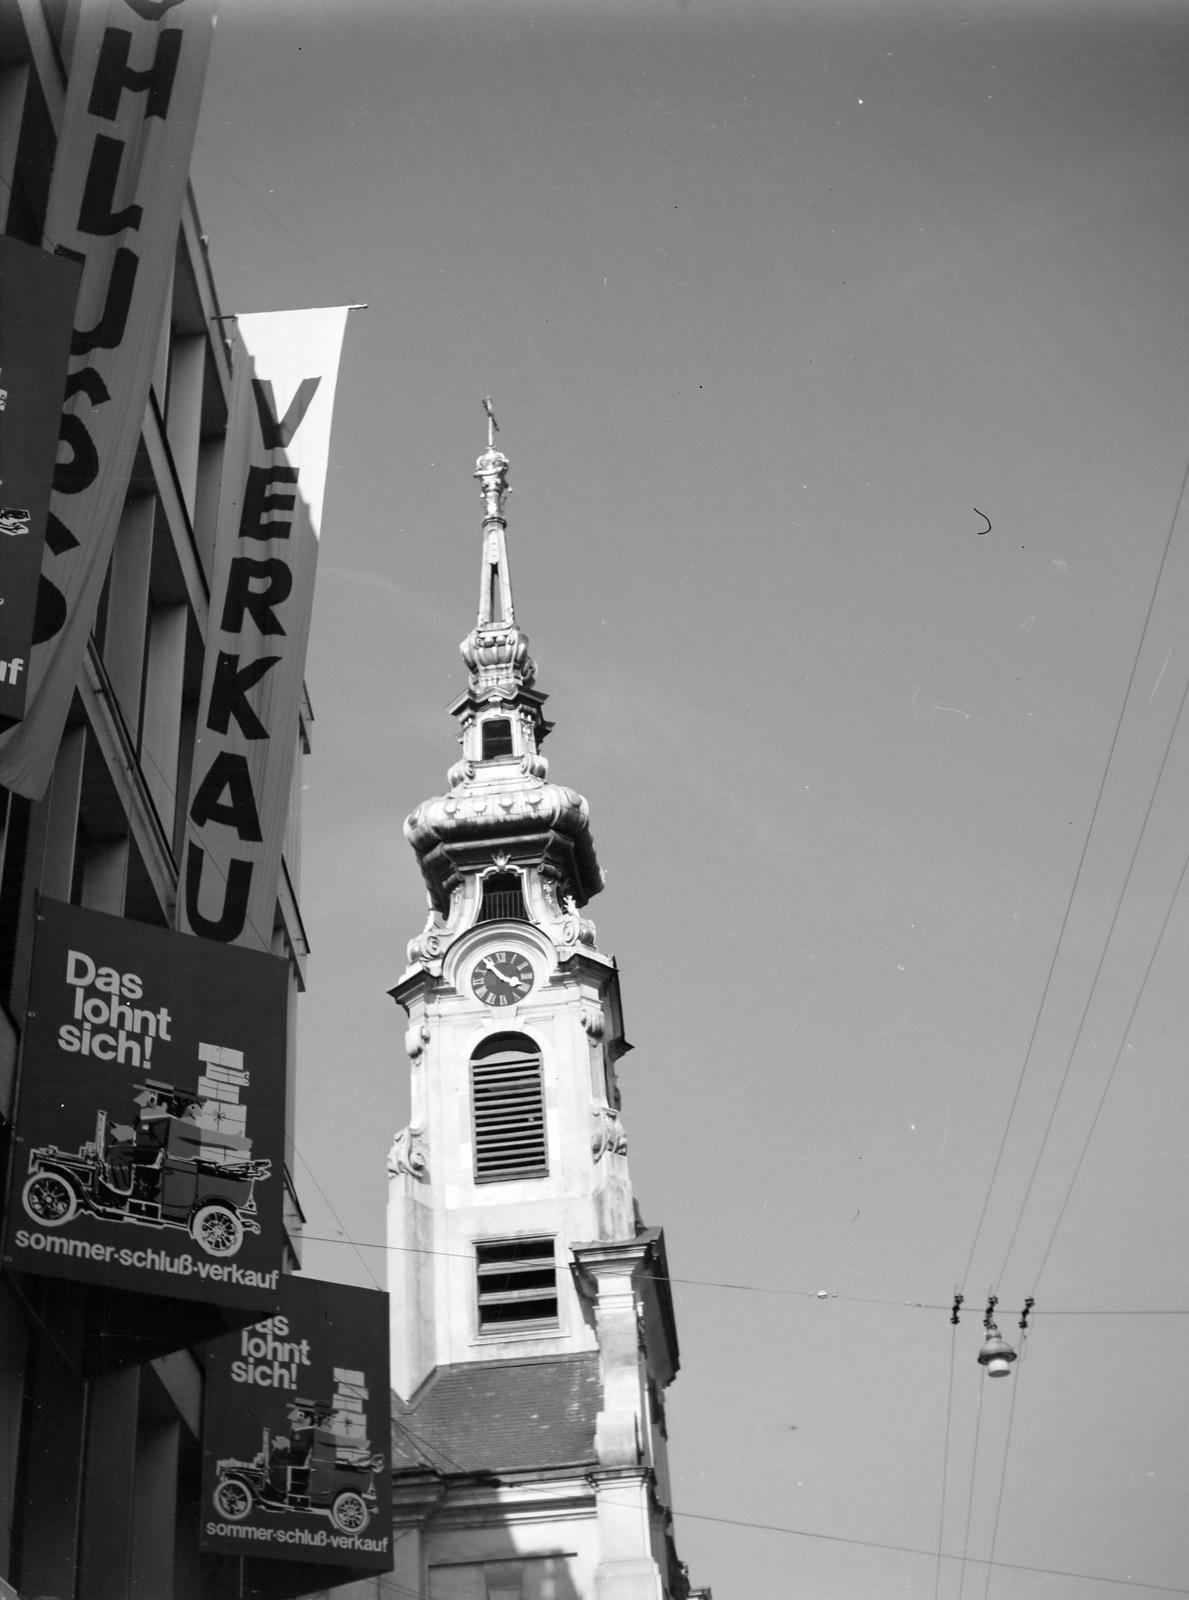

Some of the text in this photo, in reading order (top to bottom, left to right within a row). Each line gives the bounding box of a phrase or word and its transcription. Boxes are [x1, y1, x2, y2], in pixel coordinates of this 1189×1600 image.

[65, 950, 143, 1000] Das
[74, 987, 172, 1041] lohnt
[57, 1022, 153, 1069] sich!
[242, 1315, 289, 1336] as
[241, 1330, 312, 1366] lohnt
[230, 1357, 298, 1390] sich!
